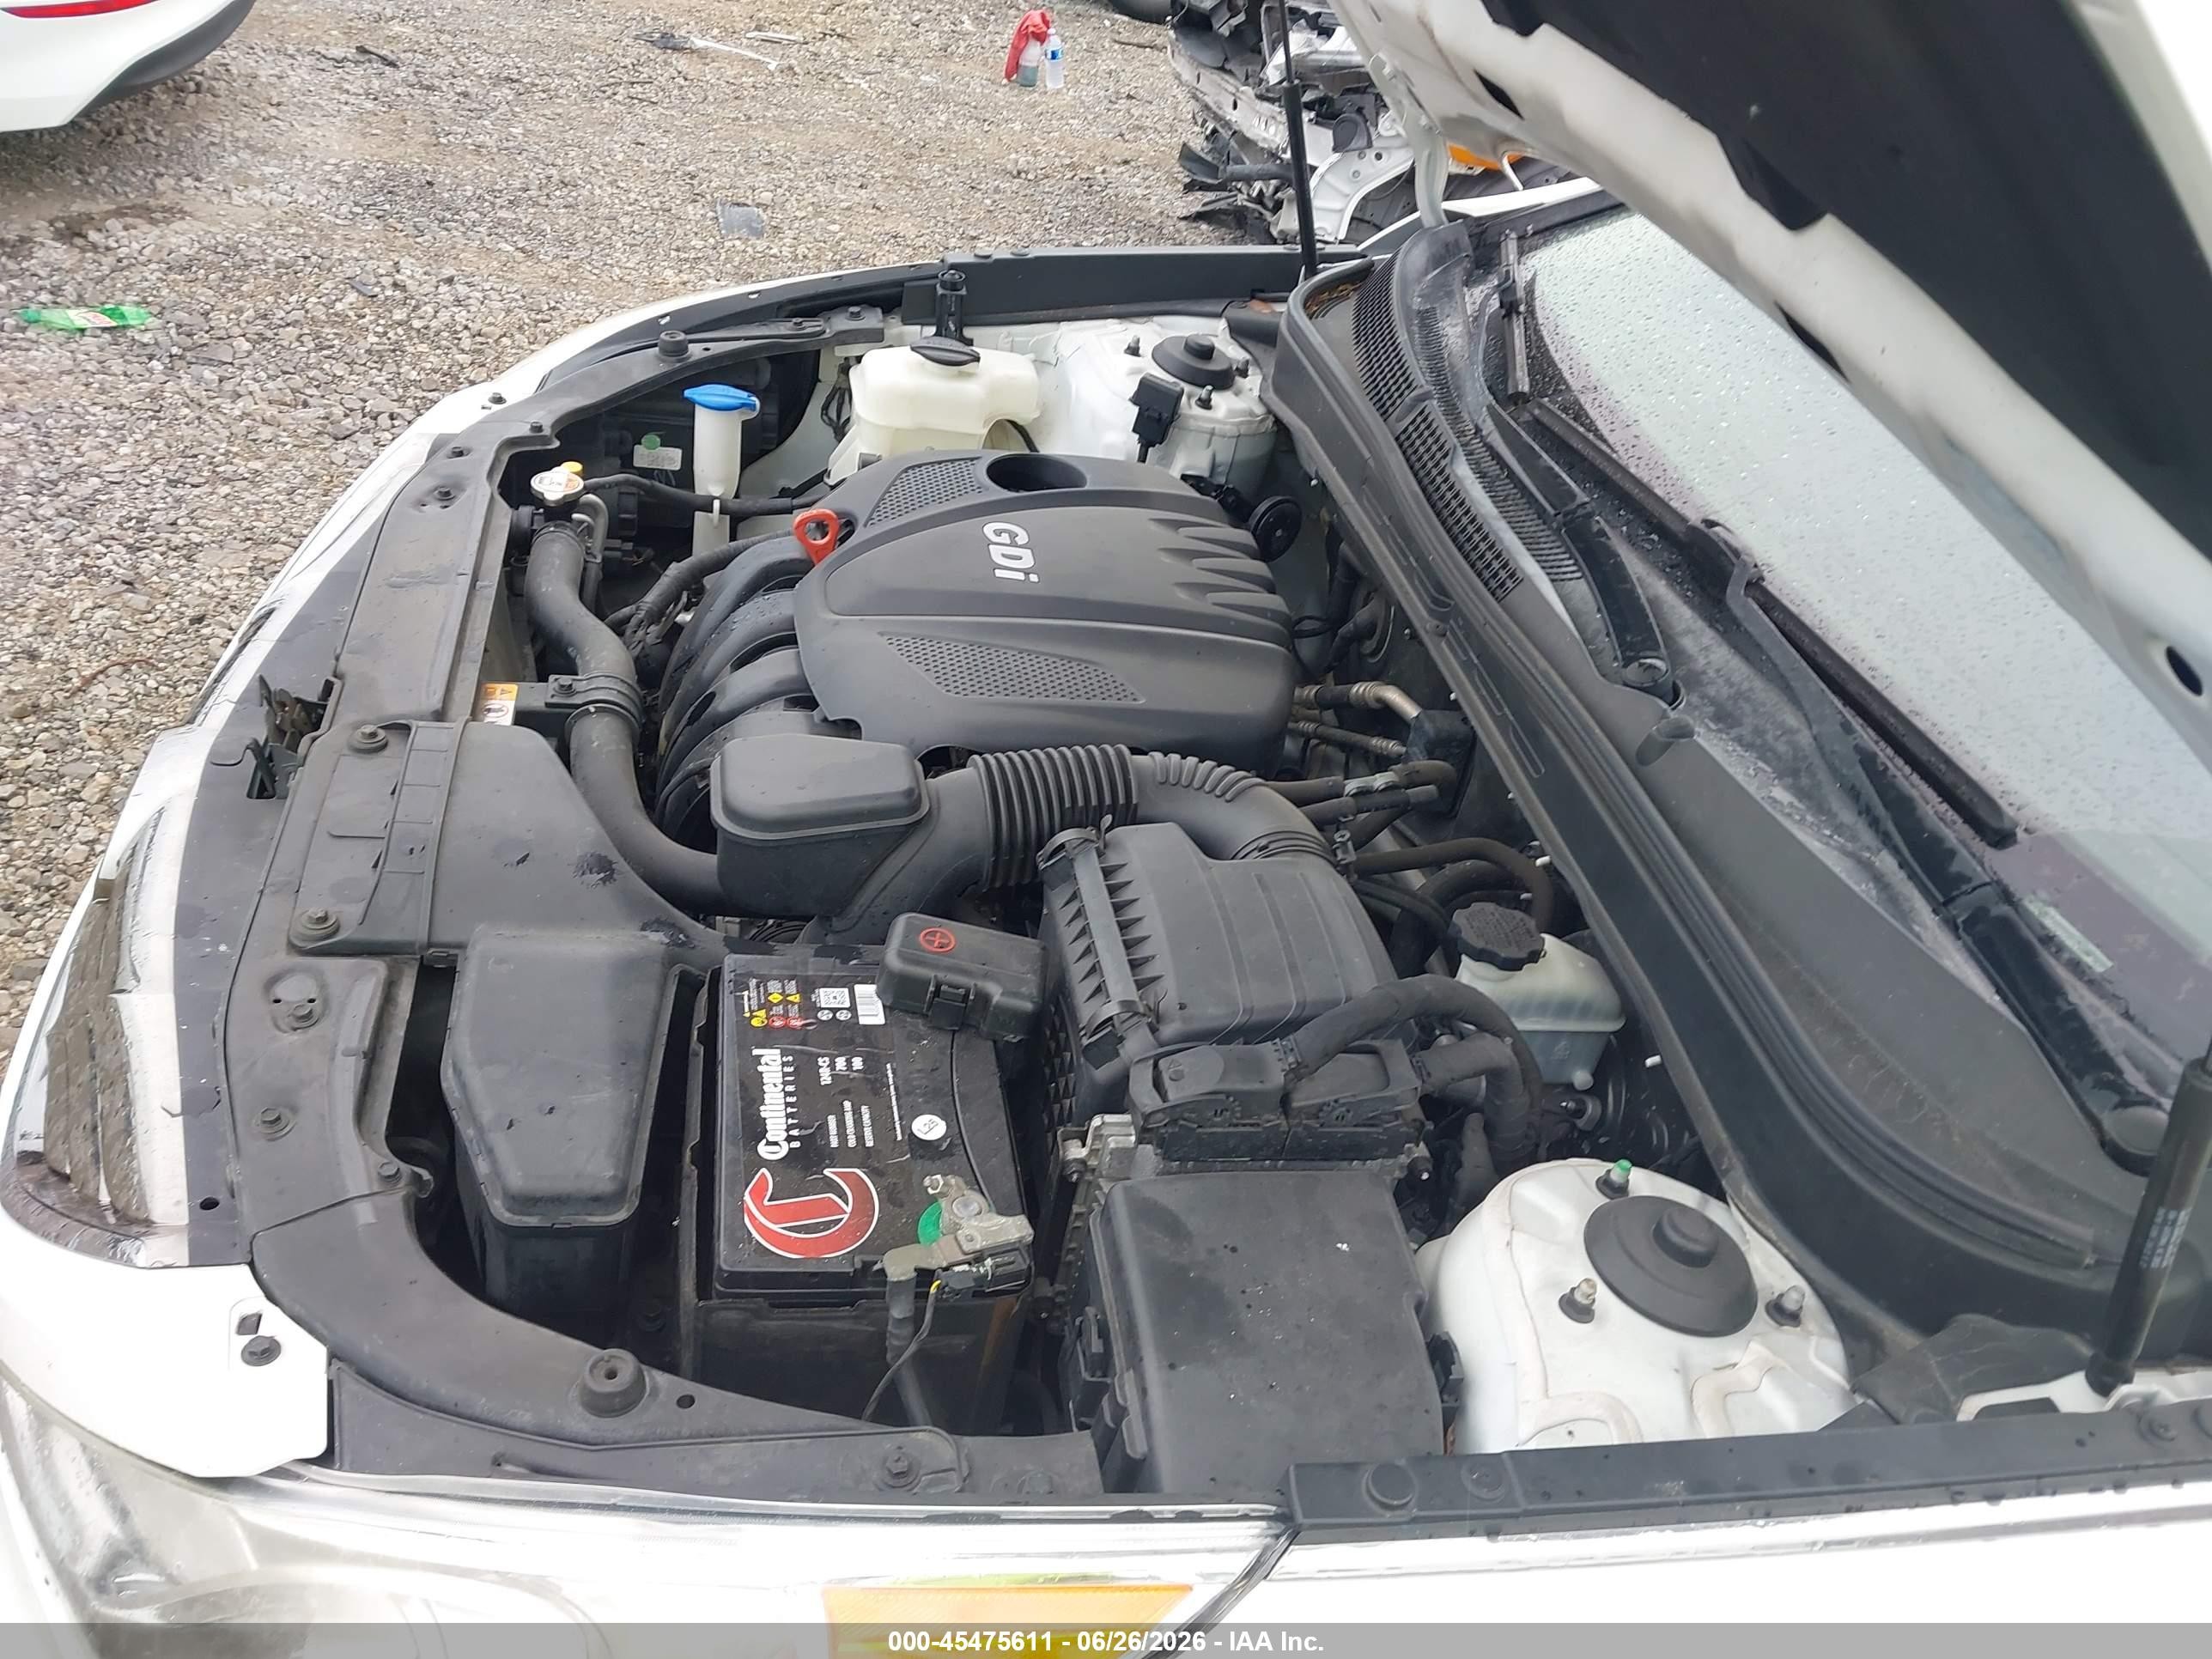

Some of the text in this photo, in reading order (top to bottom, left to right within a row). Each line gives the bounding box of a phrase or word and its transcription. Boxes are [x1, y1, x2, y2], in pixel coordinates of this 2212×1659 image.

[982, 521, 1039, 583] GDi
[835, 1056, 848, 1071] 700
[851, 1056, 864, 1071] 100
[751, 1048, 789, 1160] Continental
[781, 1055, 801, 1148] BATTERIES
